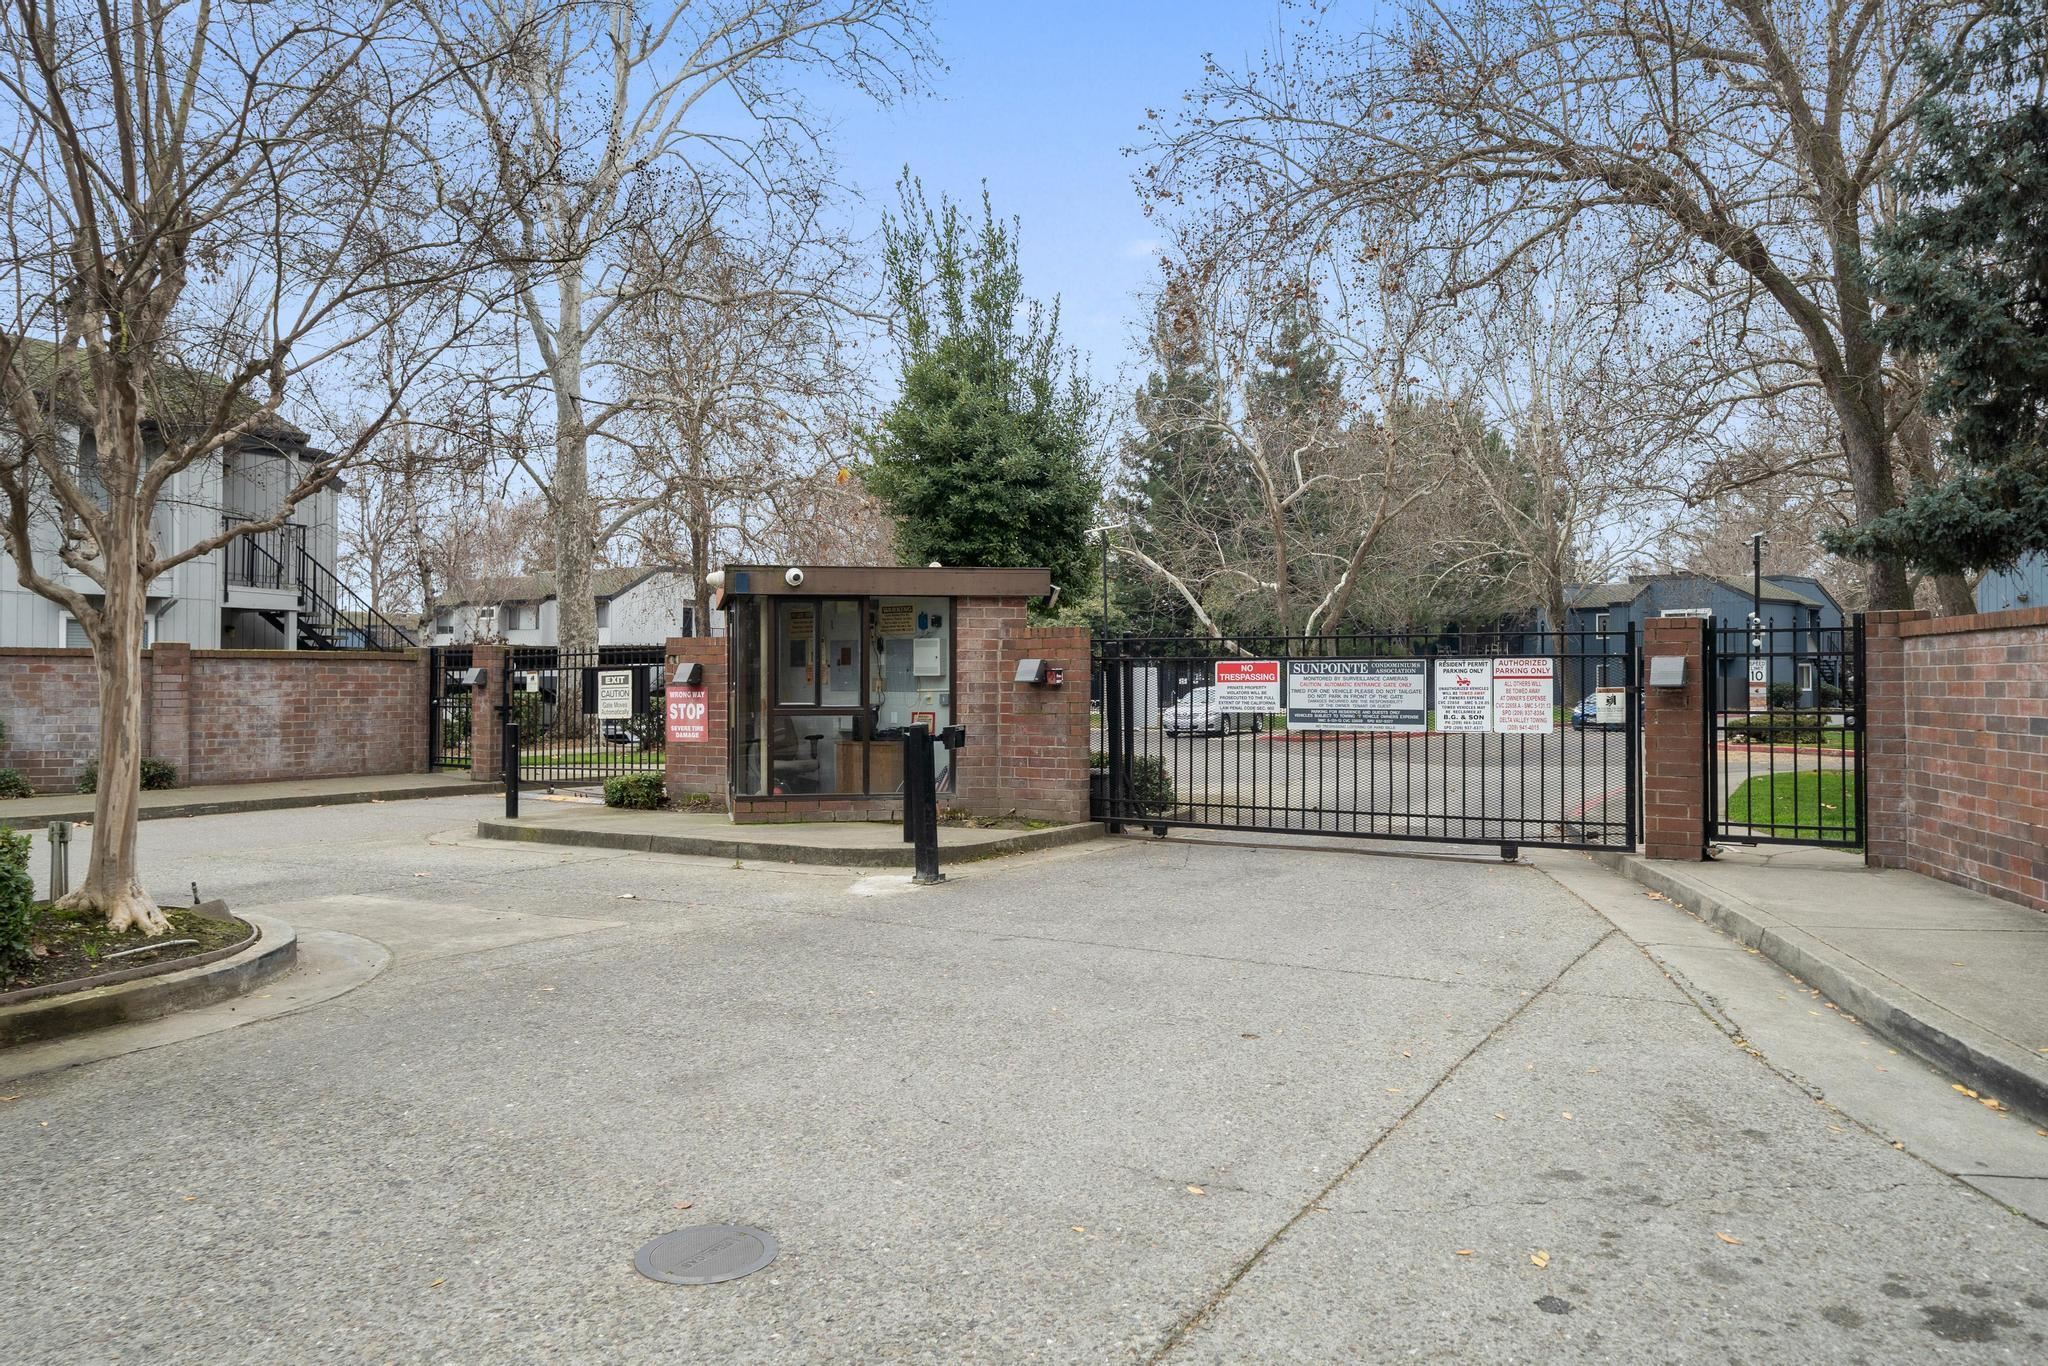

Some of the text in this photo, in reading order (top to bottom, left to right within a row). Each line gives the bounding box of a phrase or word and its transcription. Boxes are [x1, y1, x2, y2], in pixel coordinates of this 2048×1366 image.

[1293, 663, 1368, 673] SUNPOINTE
[1751, 671, 1763, 681] 10
[601, 690, 630, 698] CAUTION
[670, 704, 705, 720] STOP
